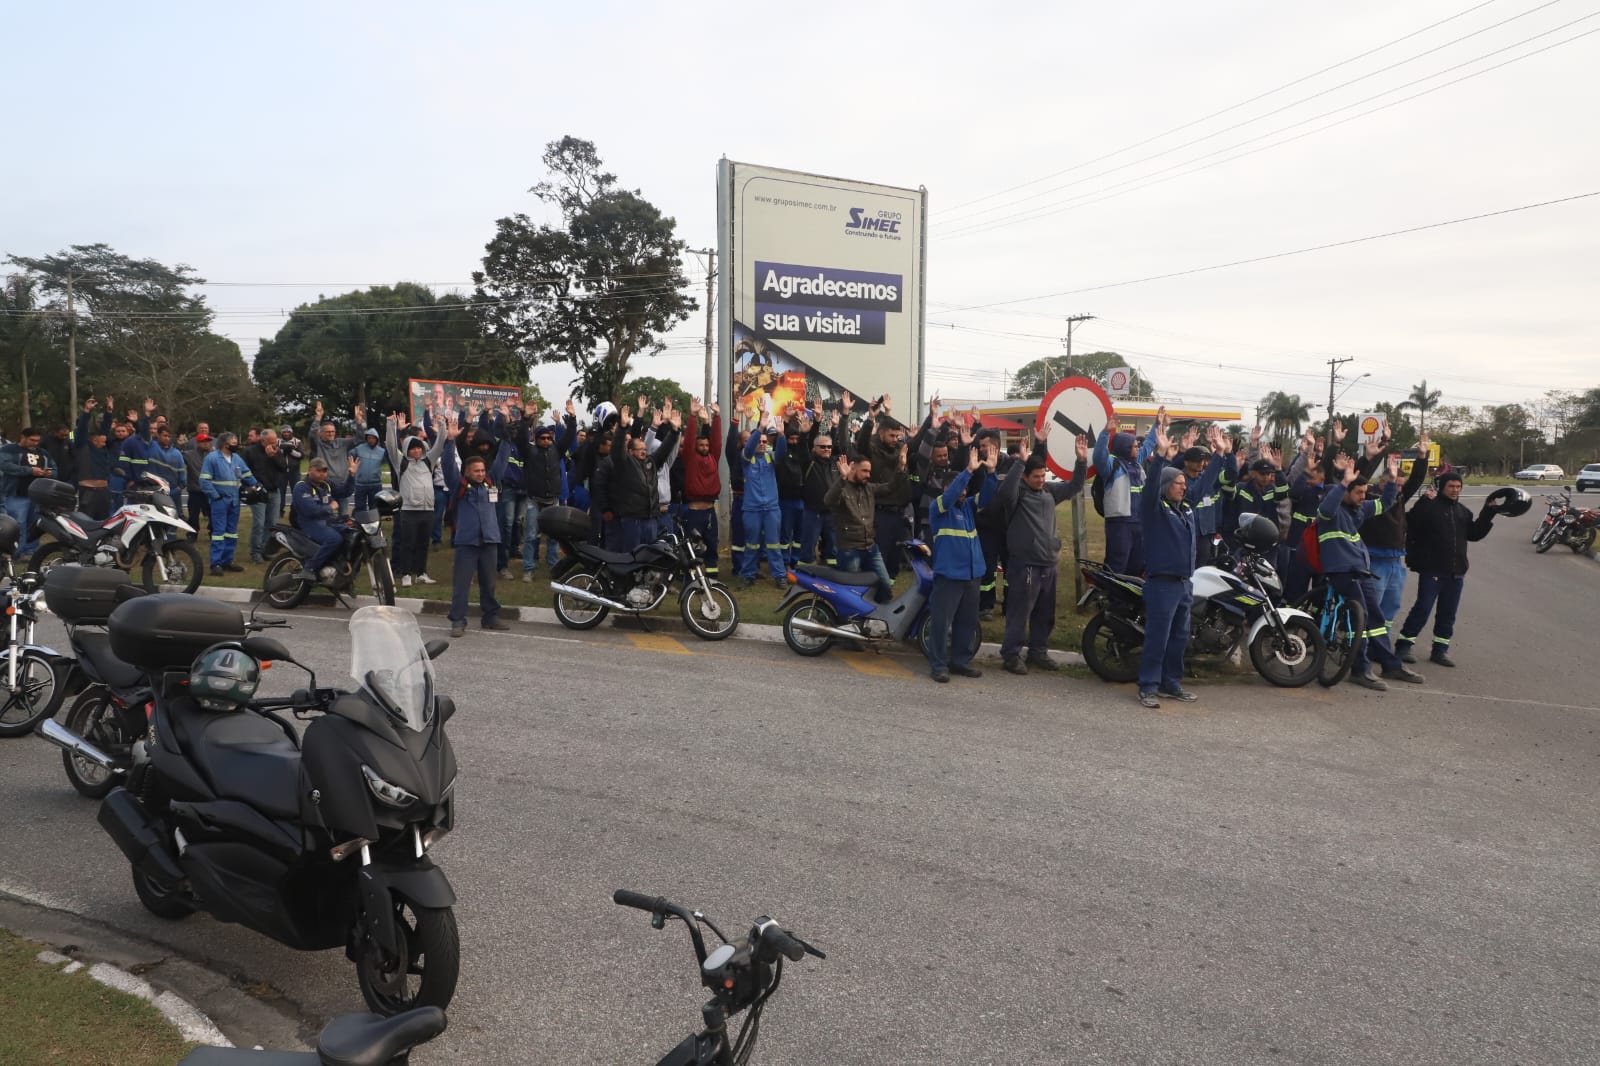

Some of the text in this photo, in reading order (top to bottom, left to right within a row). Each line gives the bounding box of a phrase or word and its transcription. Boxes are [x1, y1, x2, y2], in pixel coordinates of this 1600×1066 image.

[754, 195, 837, 212] www.gruposimec.com.br
[846, 207, 901, 233] SIMEC
[877, 210, 901, 220] GRUPO
[845, 229, 878, 238] Construindo
[763, 269, 897, 301] Agradecemos
[763, 310, 861, 335] sua visita!
